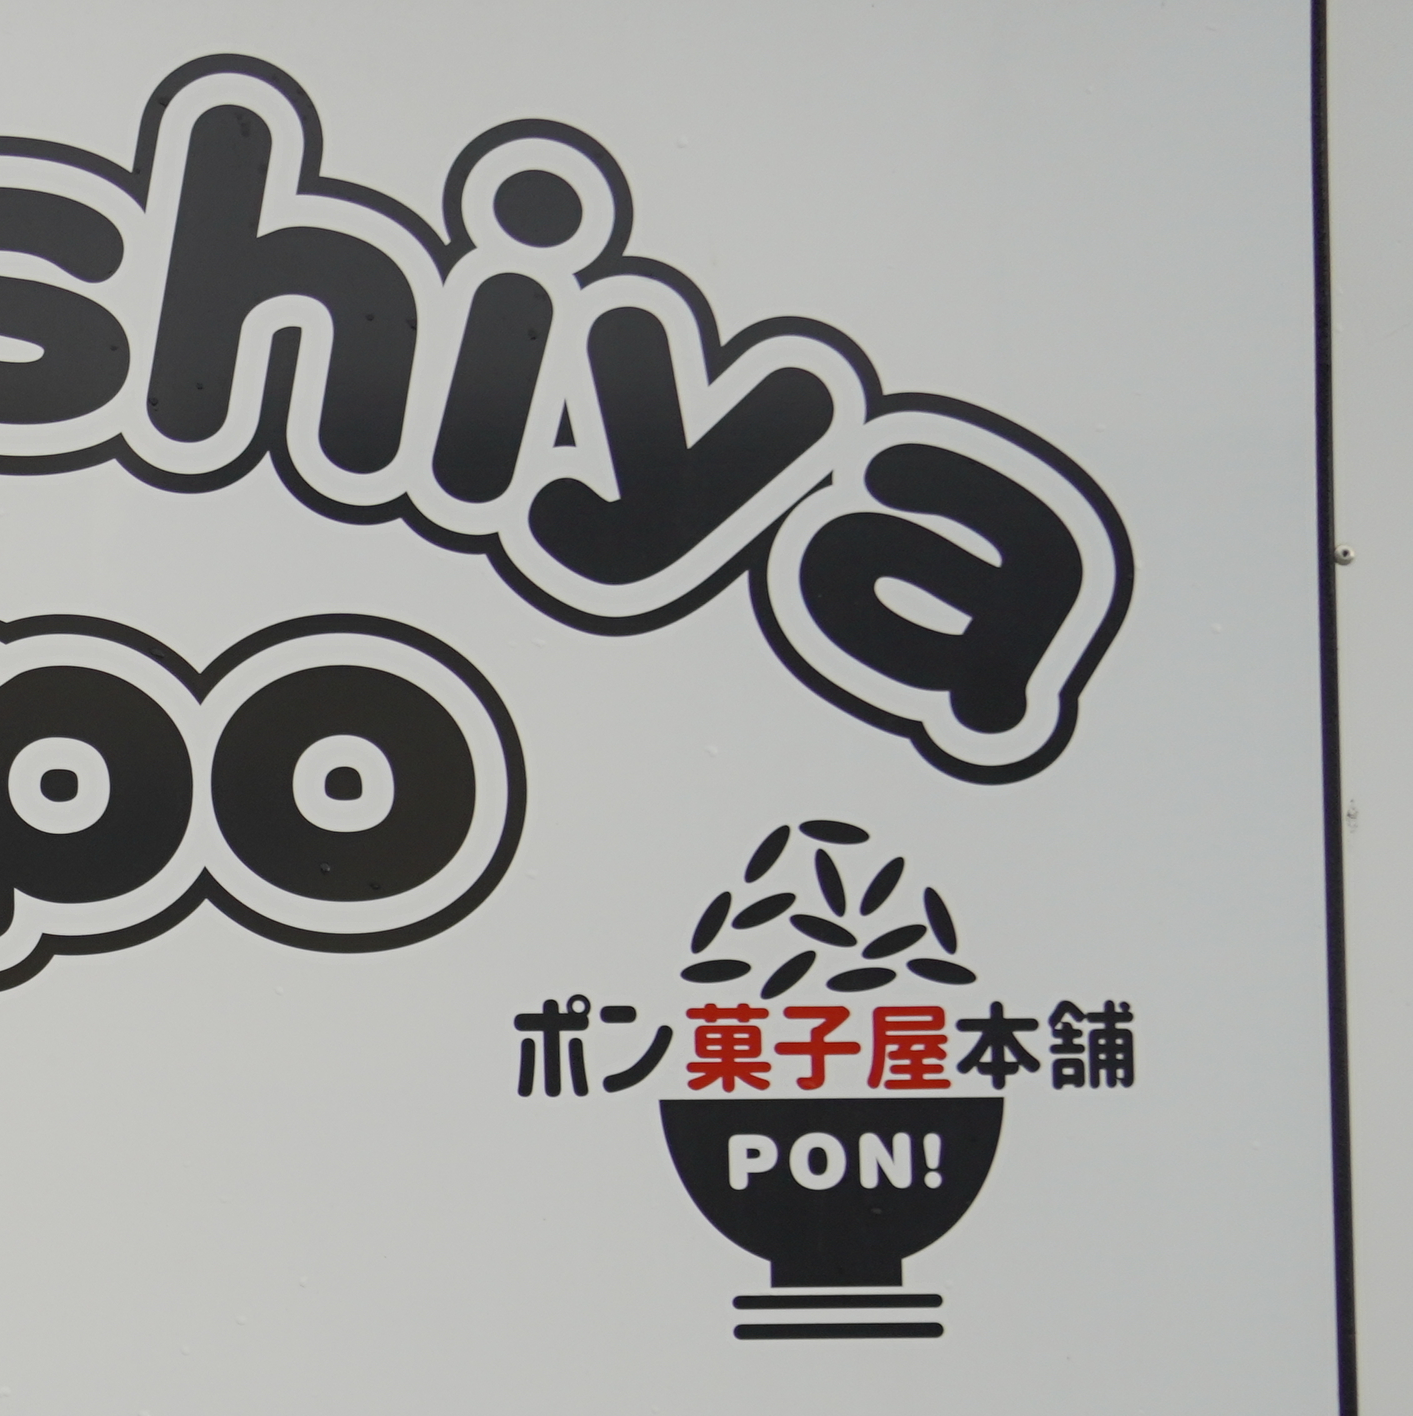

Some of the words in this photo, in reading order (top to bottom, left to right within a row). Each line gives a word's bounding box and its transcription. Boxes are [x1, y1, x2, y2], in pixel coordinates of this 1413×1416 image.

[514, 994, 1134, 1097] ポン菓子屋本舗
[728, 1132, 943, 1190] PON!
